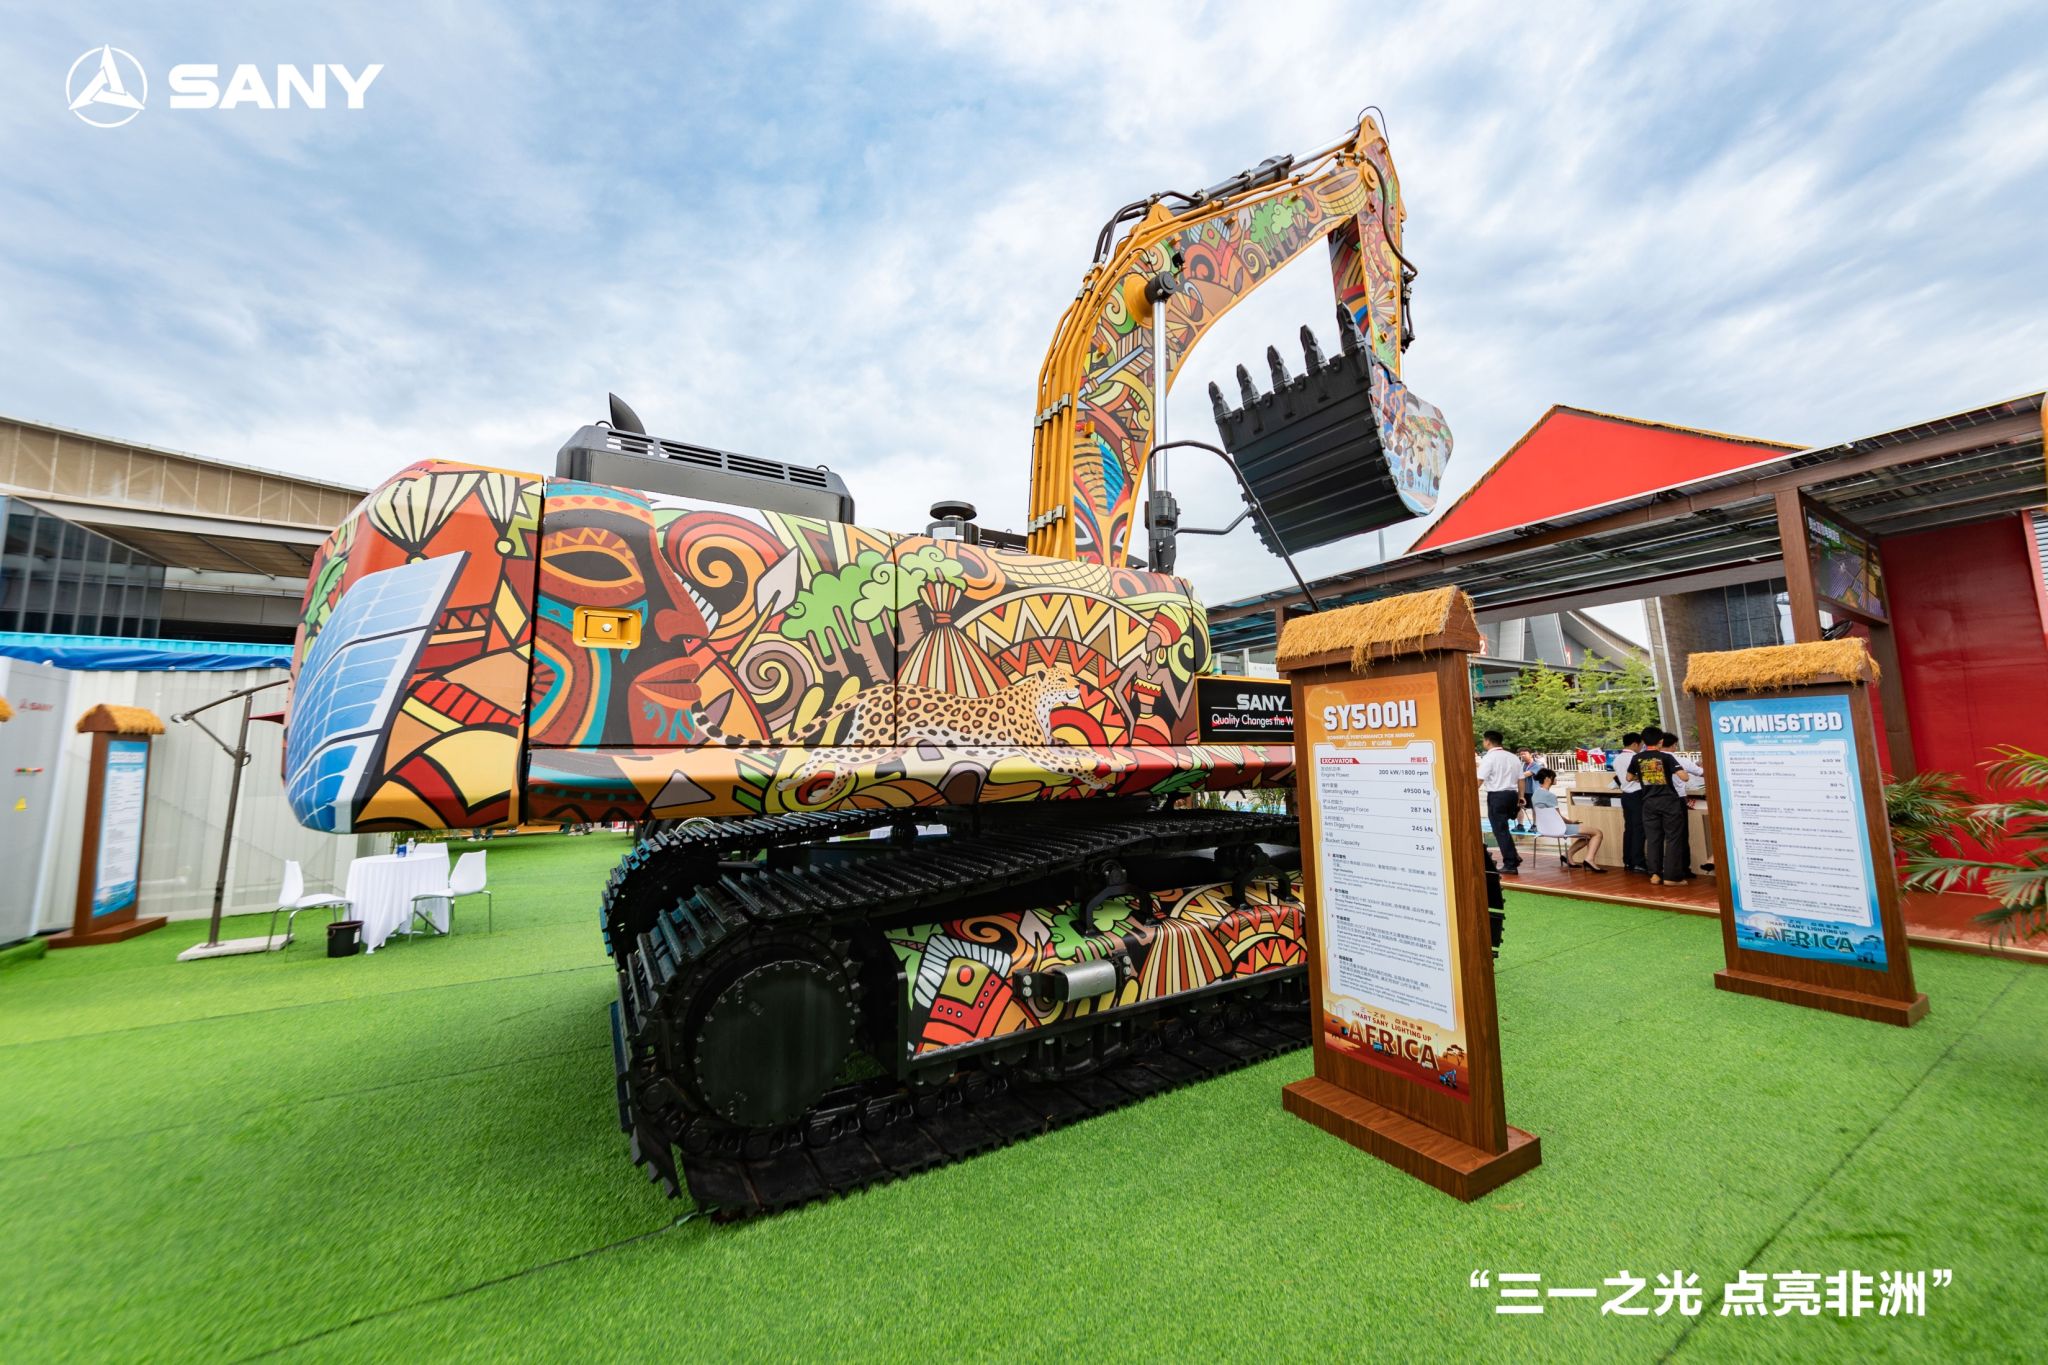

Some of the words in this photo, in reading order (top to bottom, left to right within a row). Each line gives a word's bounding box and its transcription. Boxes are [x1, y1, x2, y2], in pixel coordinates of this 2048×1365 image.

[1479, 639, 1487, 655] 2
[1236, 694, 1286, 711] SANY
[1212, 713, 1240, 727] Quality
[1241, 714, 1273, 728] Changes
[1274, 715, 1285, 726] the
[1323, 700, 1417, 731] SY500H
[1424, 825, 1434, 833] kN
[1763, 927, 1856, 953] AFRICA
[1372, 1018, 1389, 1028] SANY
[1391, 1023, 1422, 1039] LIGHTING
[1422, 1034, 1432, 1042] UP
[1348, 1019, 1440, 1071] AFRICA
